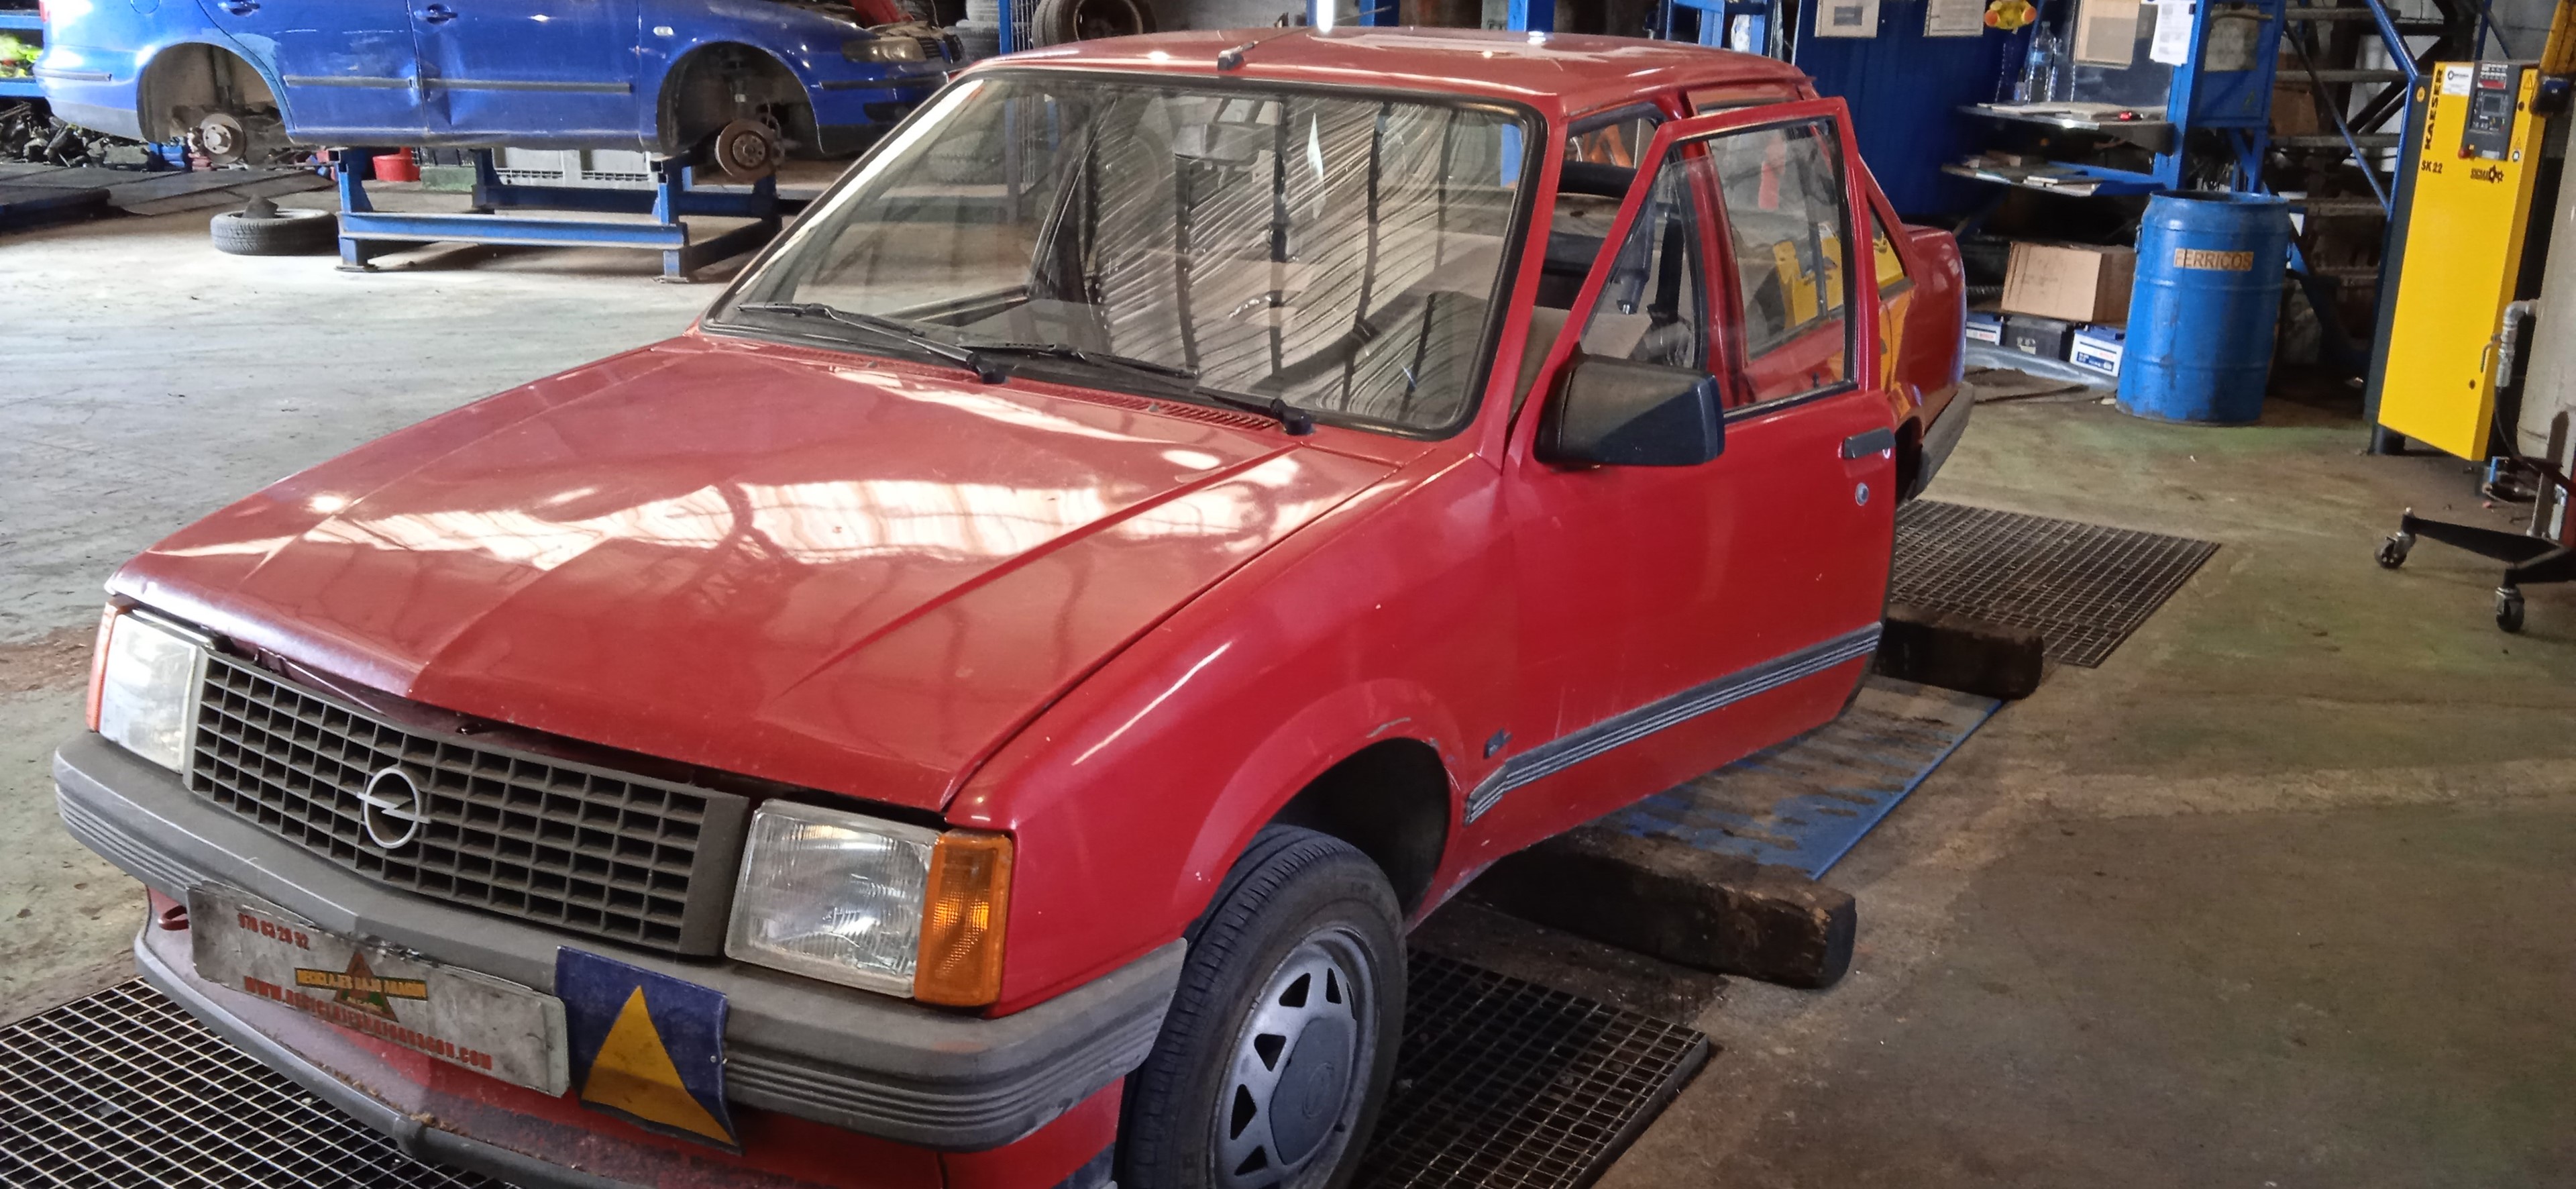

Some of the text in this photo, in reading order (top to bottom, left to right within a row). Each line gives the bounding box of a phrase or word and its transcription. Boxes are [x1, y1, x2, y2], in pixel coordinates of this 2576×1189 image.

[2424, 68, 2443, 150] KAESER
[2421, 160, 2443, 174] SK 22
[2175, 249, 2253, 270] FERRICOS
